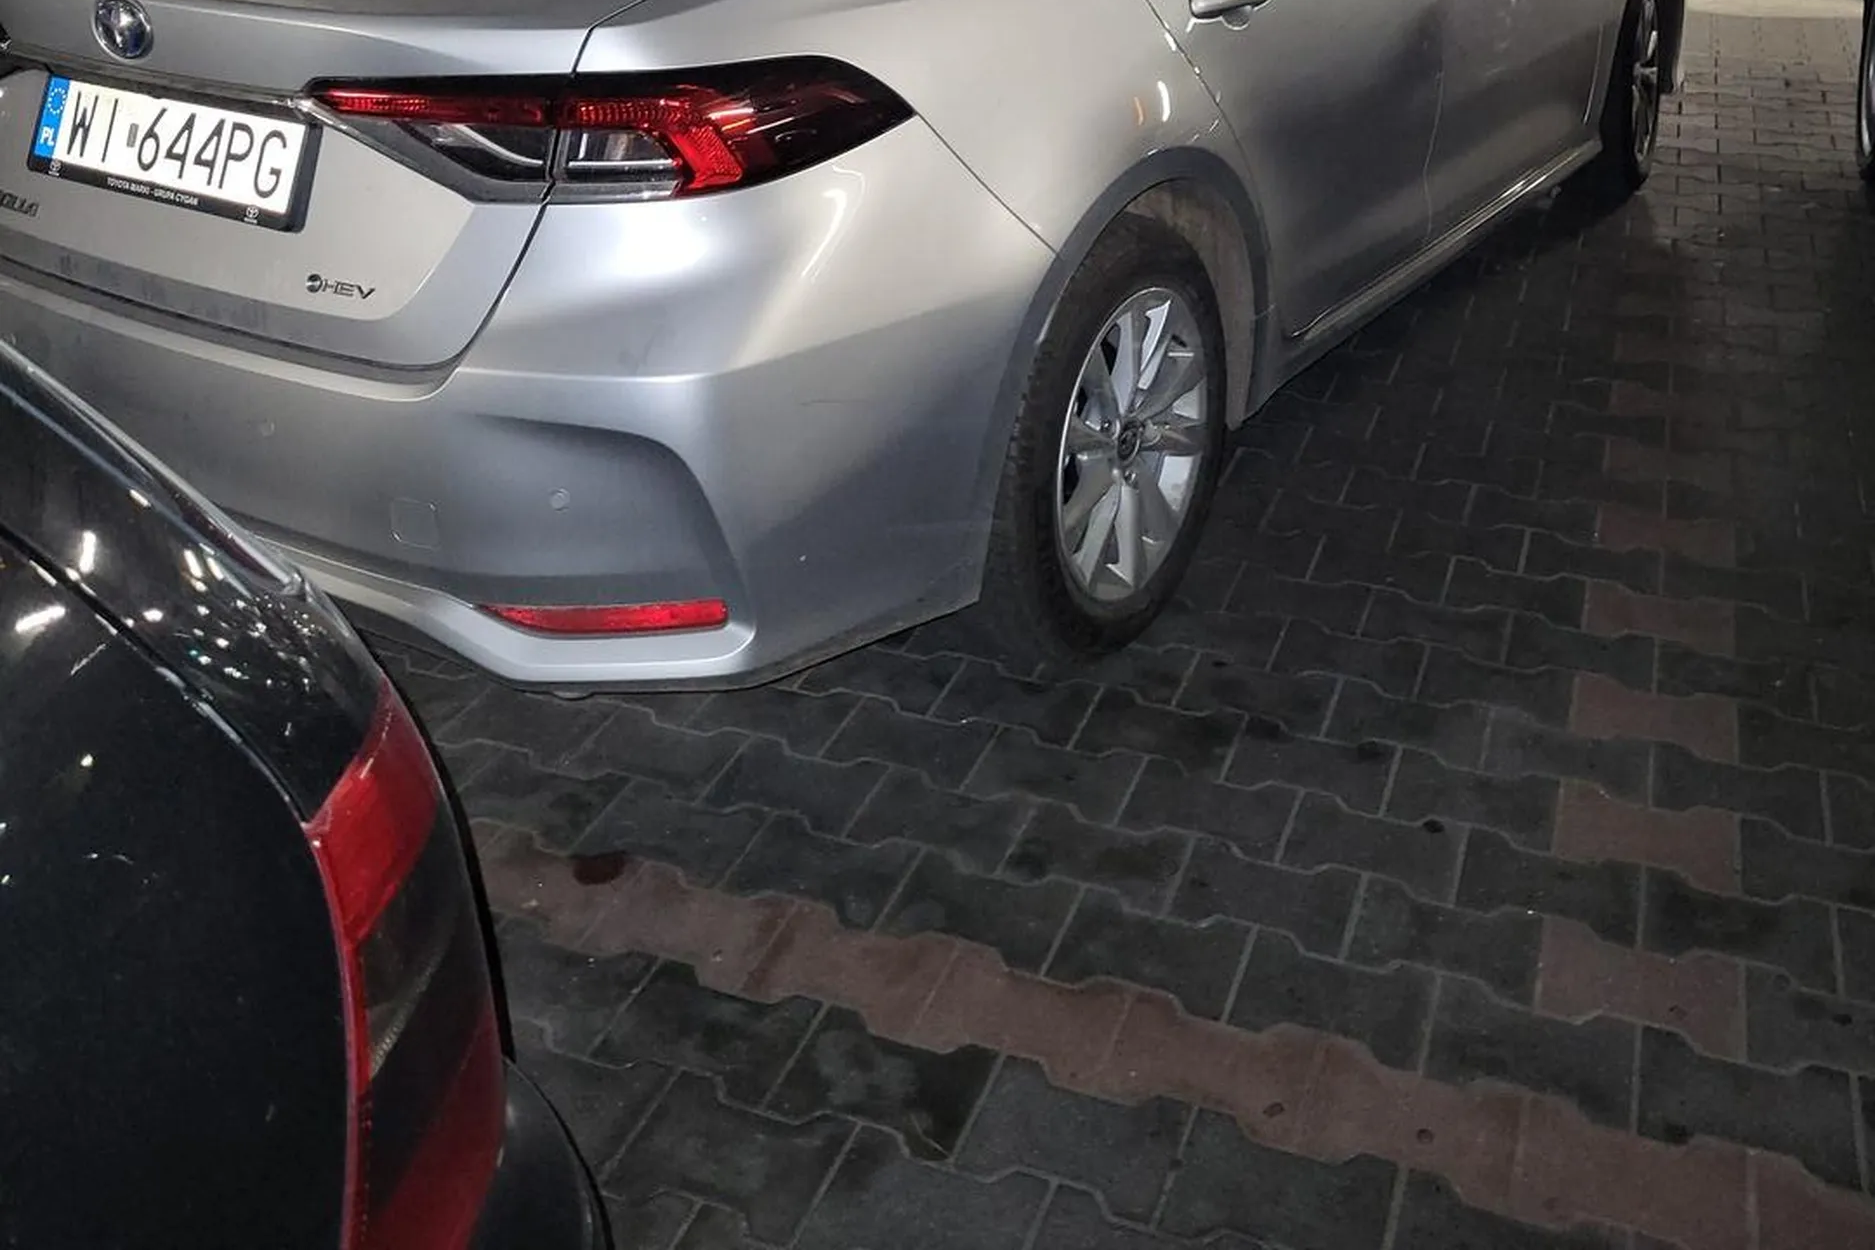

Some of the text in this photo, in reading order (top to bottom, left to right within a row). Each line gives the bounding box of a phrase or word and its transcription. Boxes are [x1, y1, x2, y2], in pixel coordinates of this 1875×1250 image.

[39, 126, 55, 146] PL
[67, 90, 288, 198] WI 644PG
[322, 279, 376, 299] HEV
